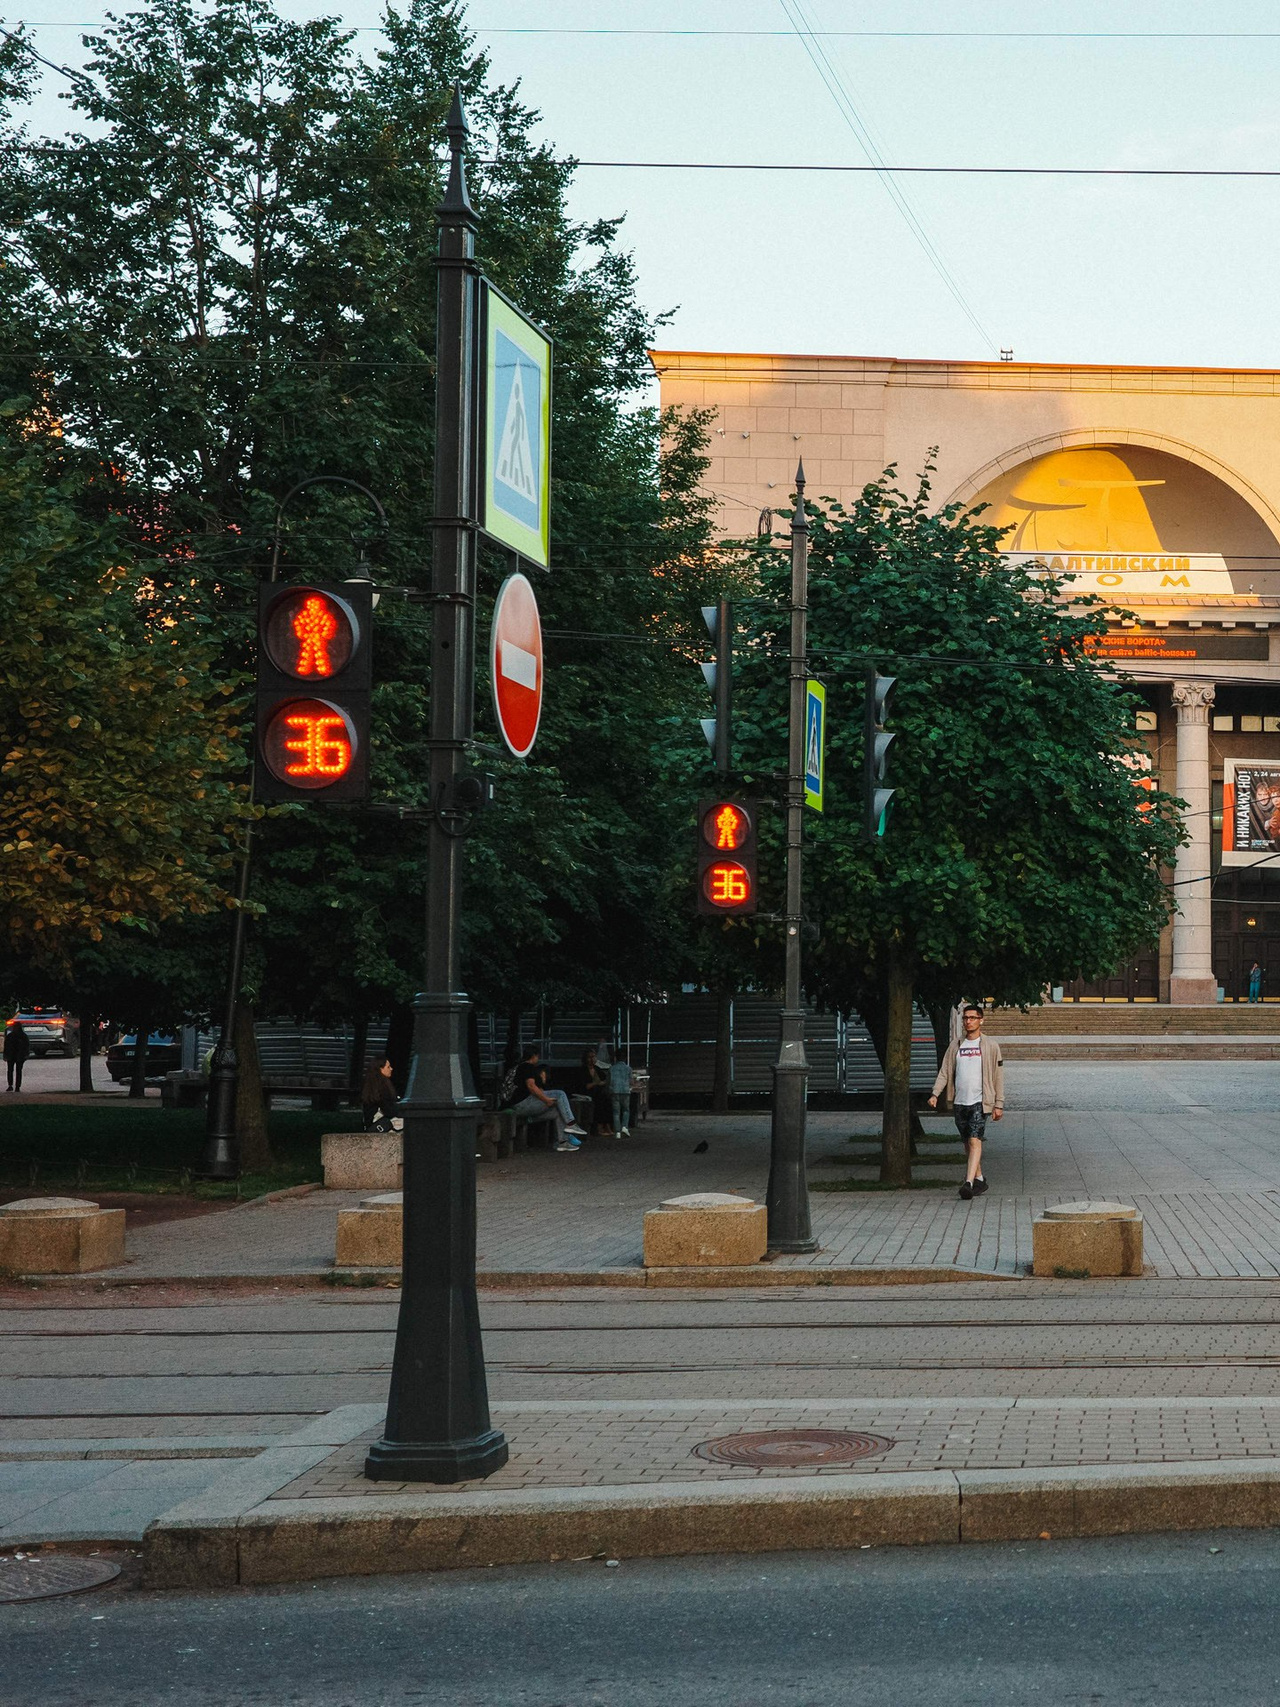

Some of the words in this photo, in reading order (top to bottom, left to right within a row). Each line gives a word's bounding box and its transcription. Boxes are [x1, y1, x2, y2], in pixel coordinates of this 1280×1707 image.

[286, 716, 350, 775] 36
[1237, 771, 1251, 789] НО!
[1236, 791, 1251, 838] НИКАКИХ
[713, 869, 746, 900] 36
